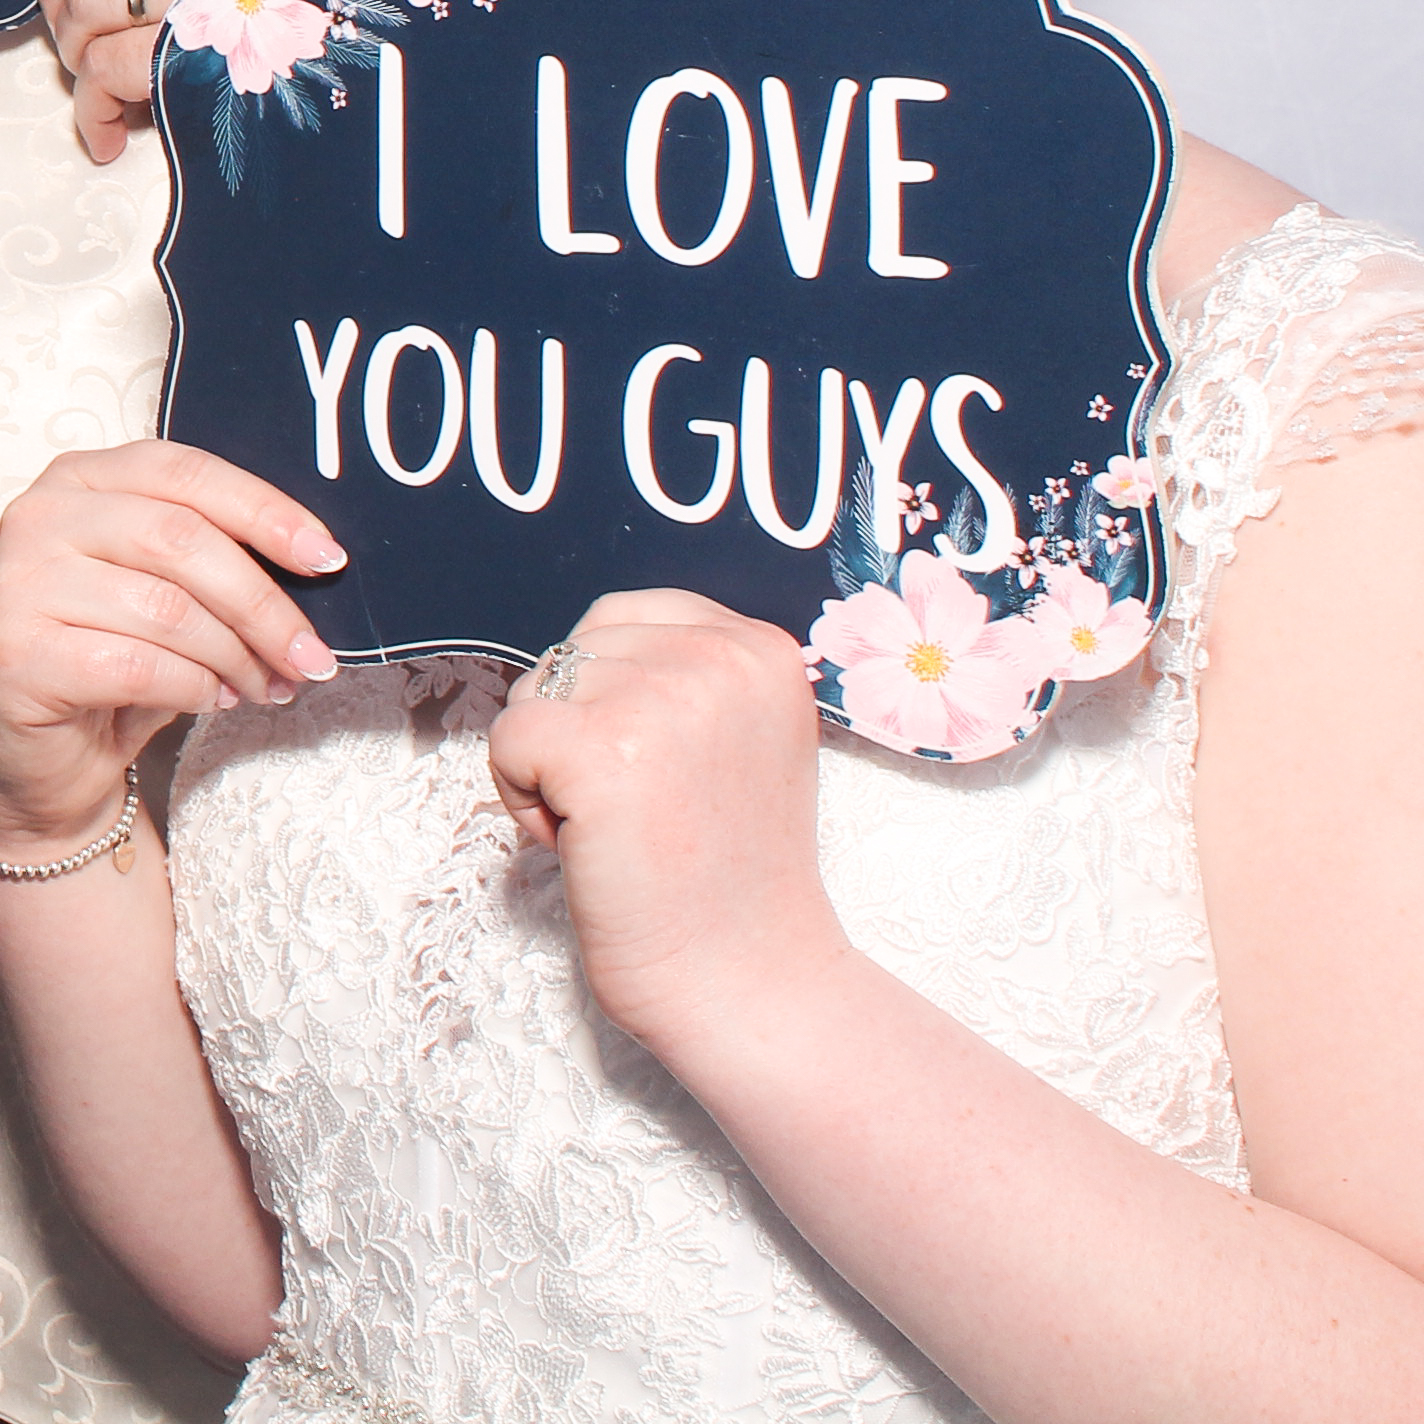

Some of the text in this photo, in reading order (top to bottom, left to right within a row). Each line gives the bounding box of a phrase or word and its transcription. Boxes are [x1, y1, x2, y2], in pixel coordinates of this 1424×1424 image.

[378, 43, 949, 280] I LOVE
[294, 317, 1018, 573] YOU GUYS
